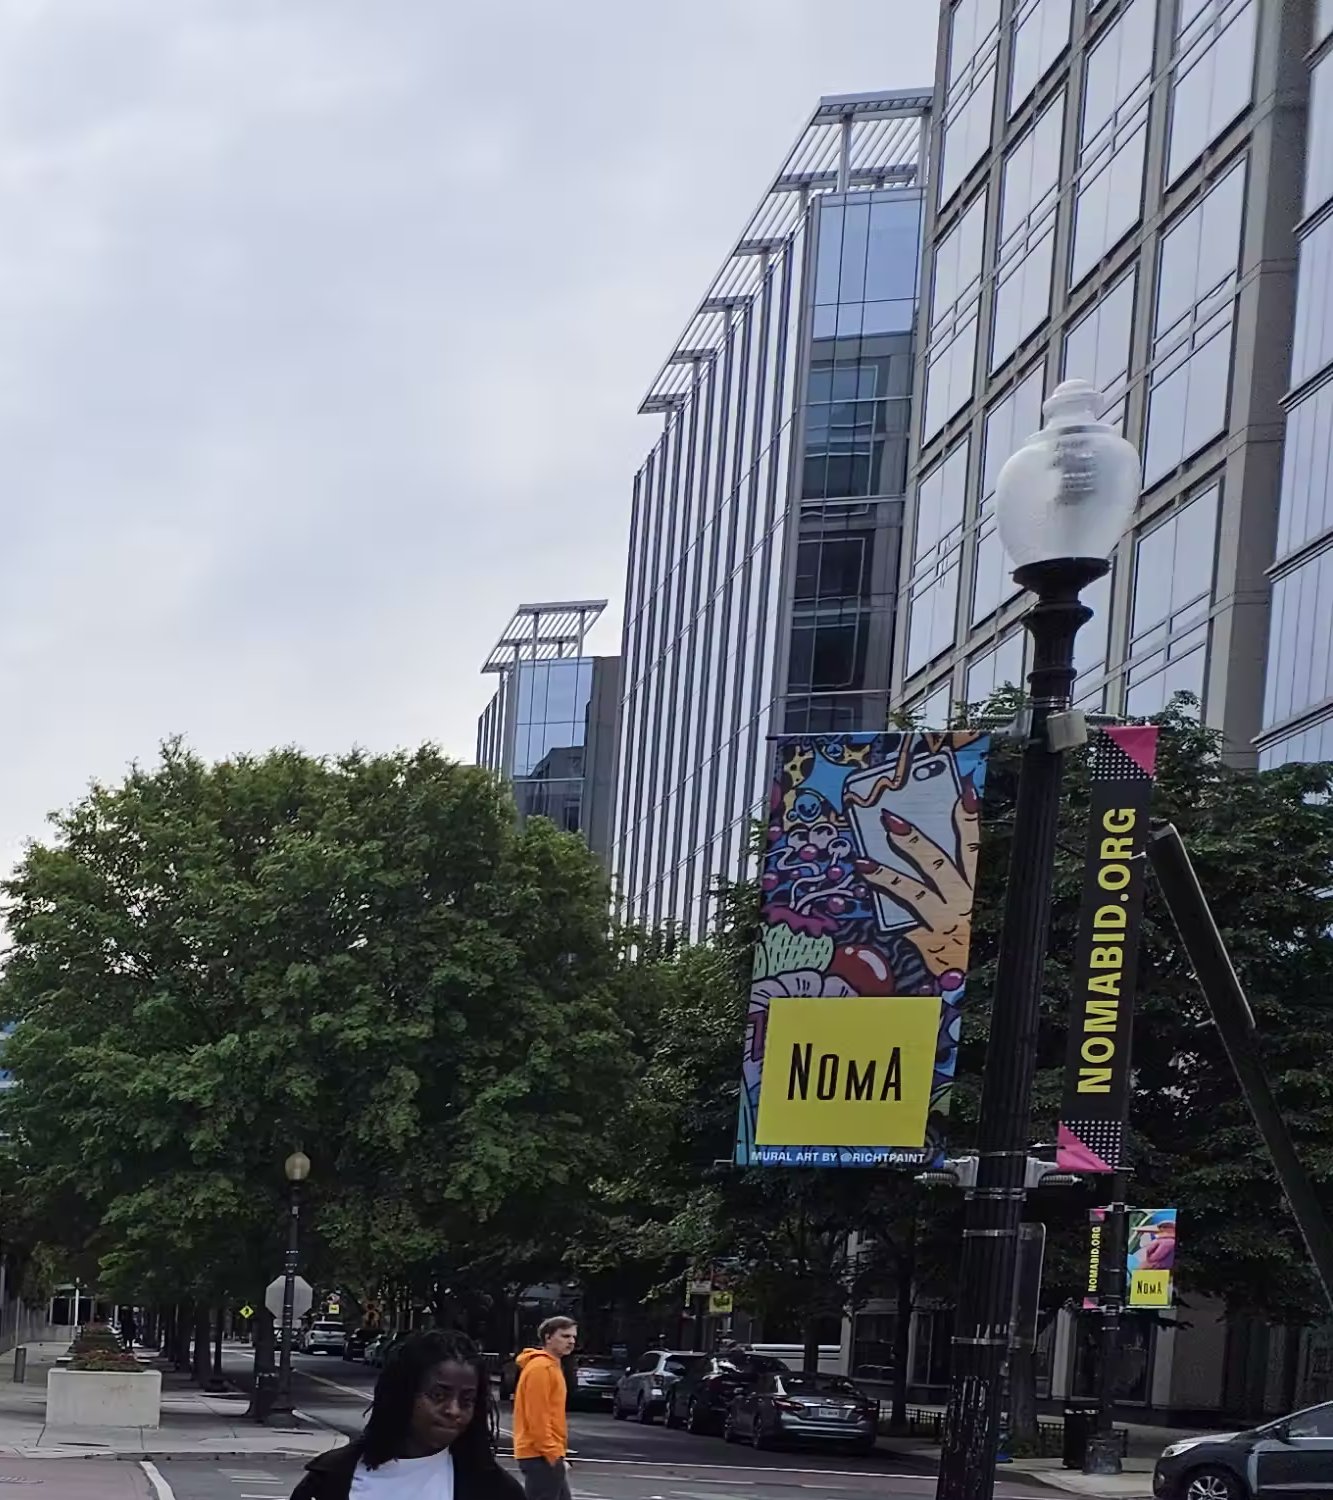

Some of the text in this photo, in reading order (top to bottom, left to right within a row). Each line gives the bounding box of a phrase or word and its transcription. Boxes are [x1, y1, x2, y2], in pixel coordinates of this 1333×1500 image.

[1077, 808, 1136, 1093] NOMABID.ORG
[751, 1151, 925, 1163] MURAL ART BY @RICHTPAINT
